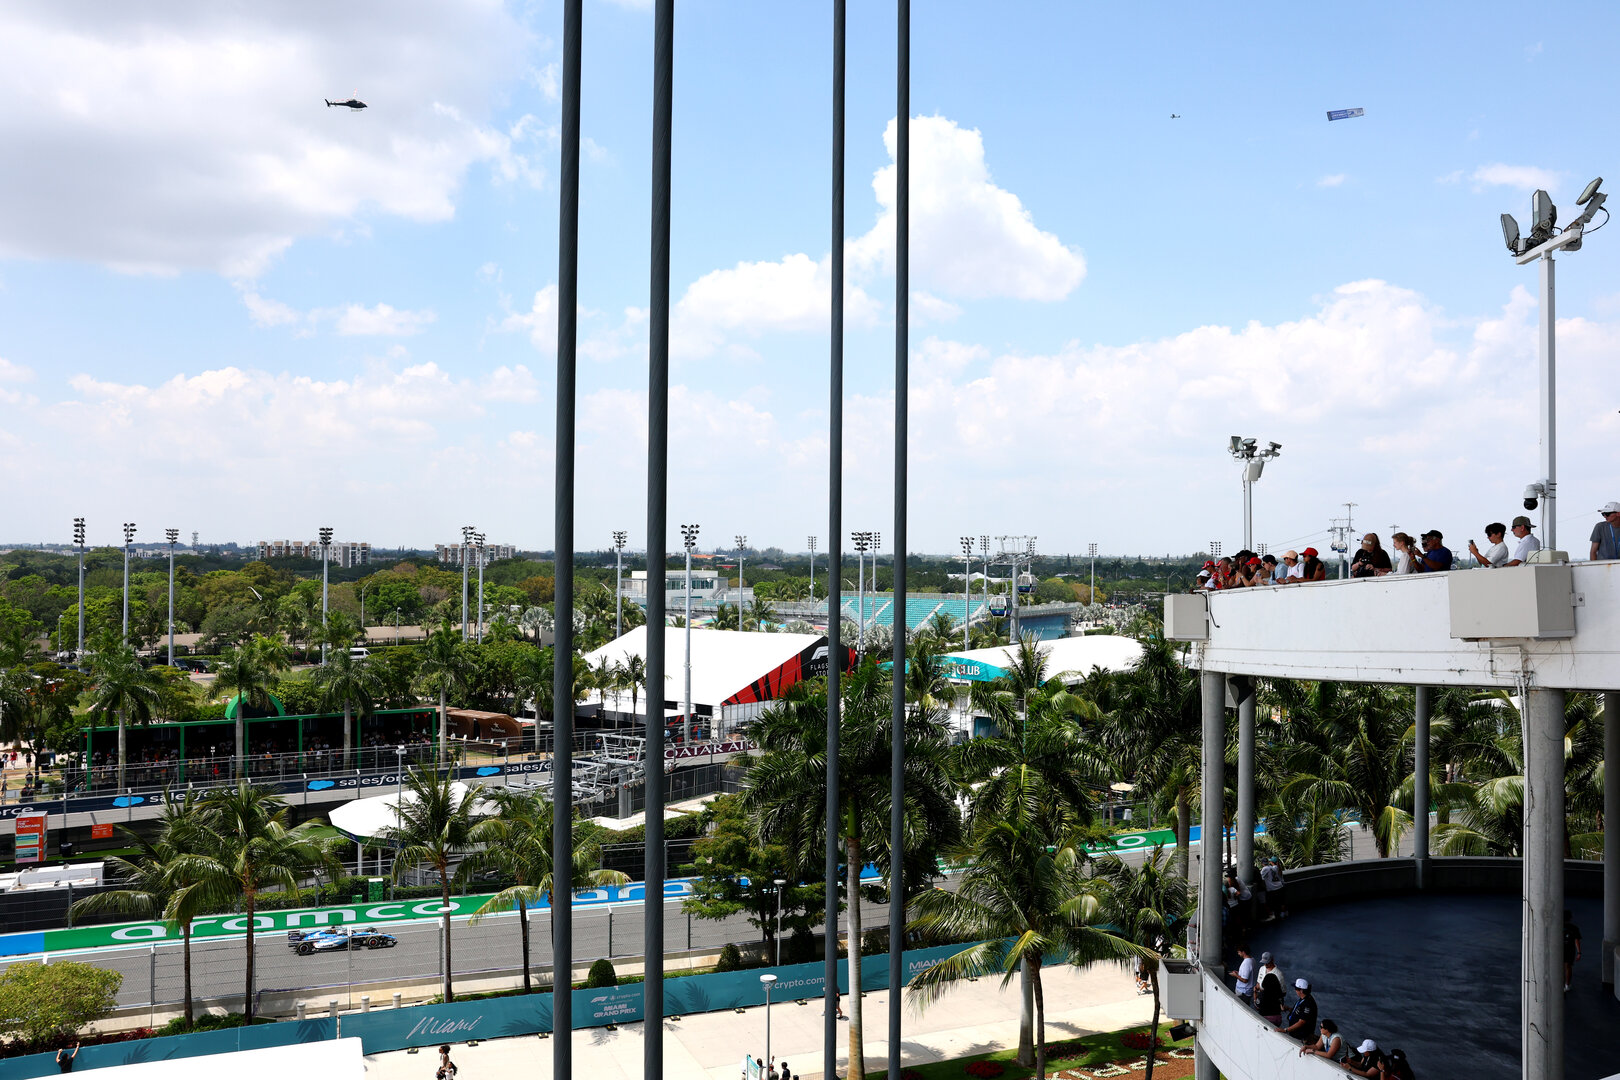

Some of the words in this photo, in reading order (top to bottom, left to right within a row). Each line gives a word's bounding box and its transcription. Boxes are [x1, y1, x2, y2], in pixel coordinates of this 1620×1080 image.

[957, 665, 980, 676] CLUB
[664, 743, 723, 759] QATAR
[504, 761, 552, 773] salesfo
[339, 774, 419, 787] saesforc
[111, 902, 460, 940] aramco
[774, 977, 825, 989] crypto.com
[593, 1010, 620, 1018] GRAND
[604, 1004, 627, 1012] MIAMI
[406, 1015, 483, 1040] Miami
